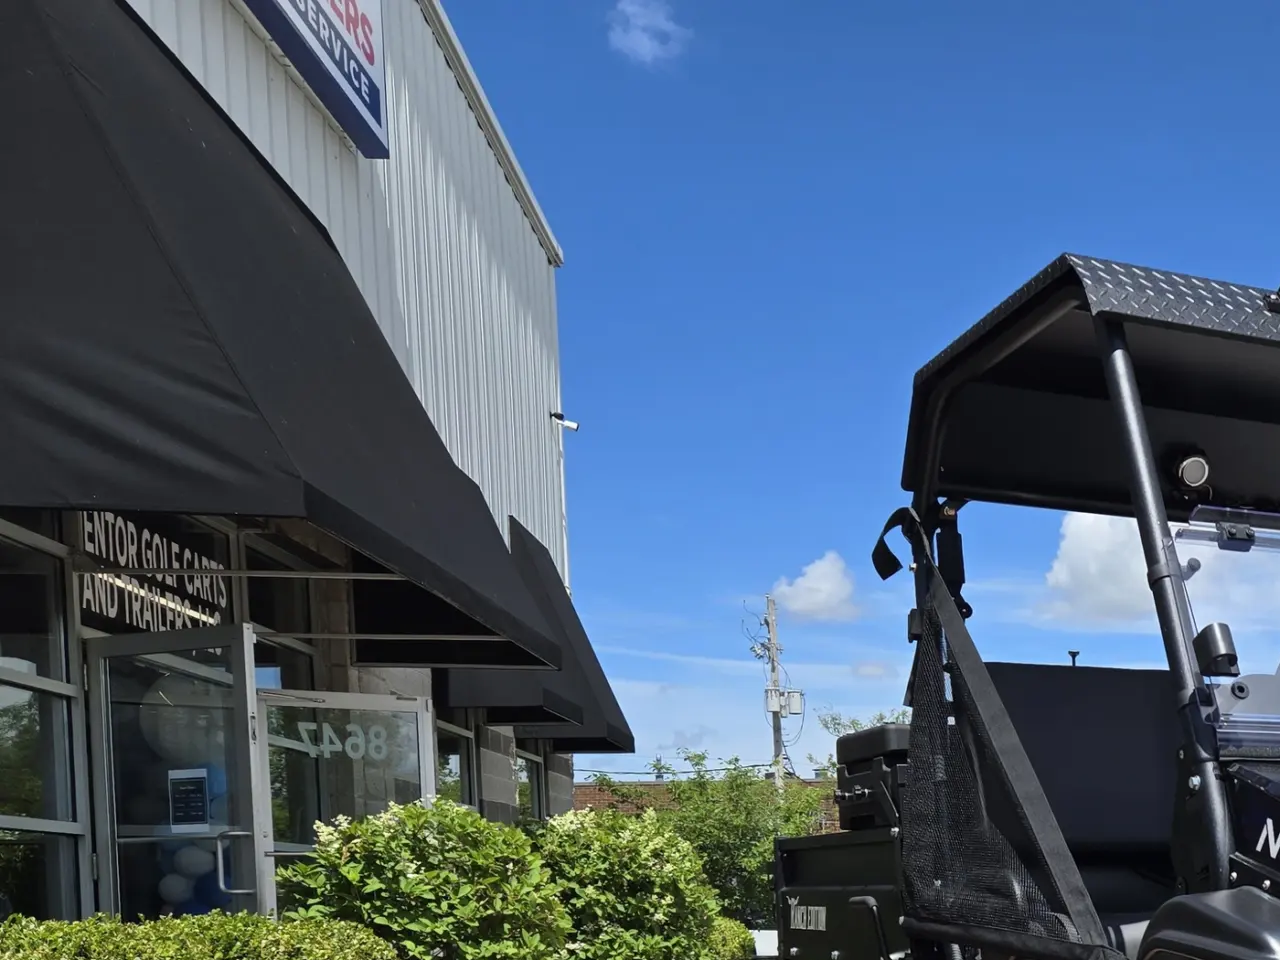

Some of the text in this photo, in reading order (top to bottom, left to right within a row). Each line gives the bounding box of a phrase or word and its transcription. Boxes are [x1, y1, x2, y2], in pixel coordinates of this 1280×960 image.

[82, 573, 118, 619] AND
[141, 528, 180, 588] GOLF
[183, 547, 227, 608] CARTS
